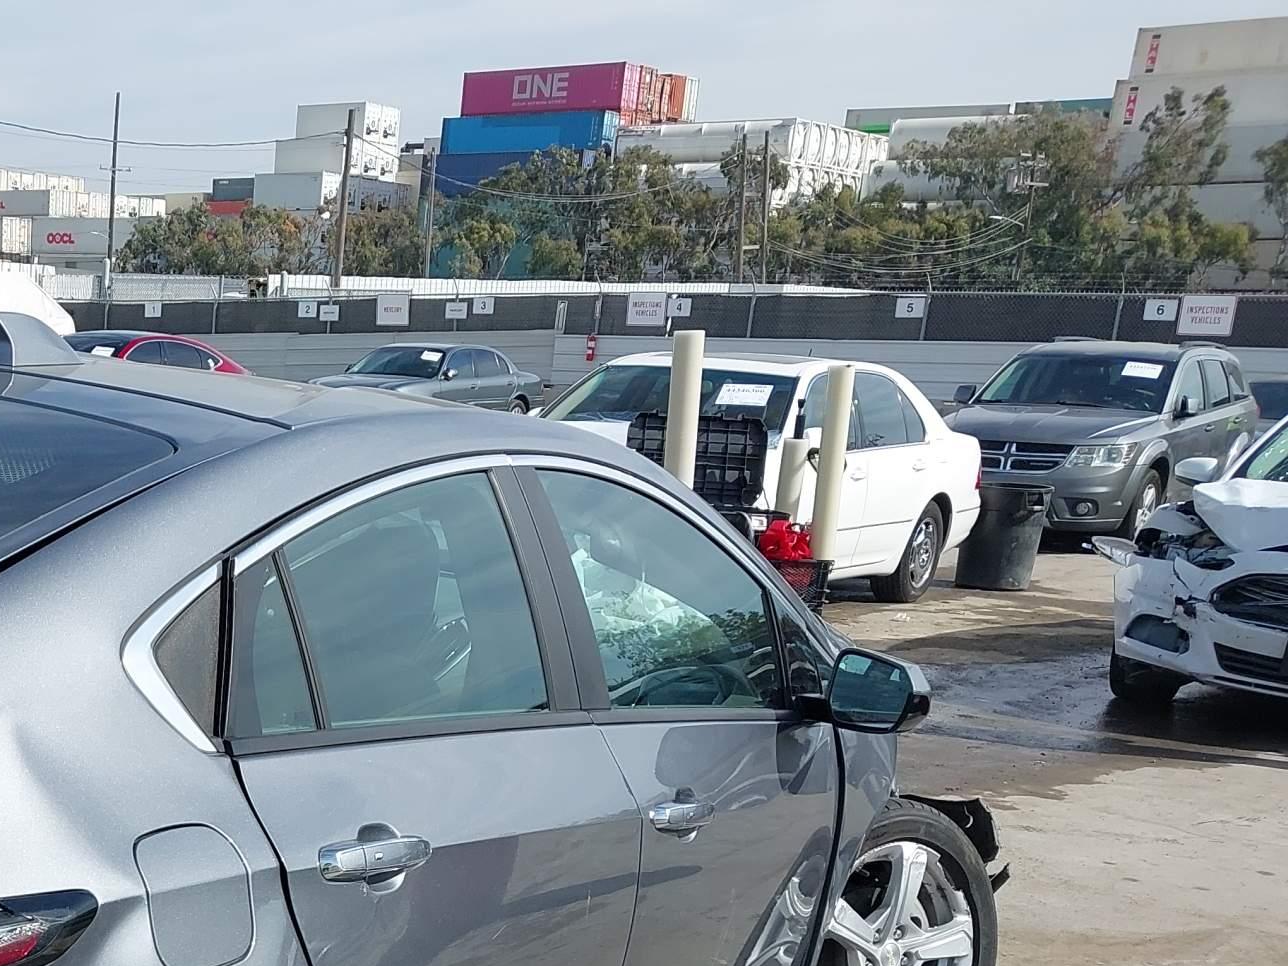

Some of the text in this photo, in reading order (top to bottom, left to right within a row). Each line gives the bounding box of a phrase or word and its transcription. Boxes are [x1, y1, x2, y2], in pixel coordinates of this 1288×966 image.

[512, 72, 569, 99] ONE
[46, 232, 75, 244] OOCL
[151, 305, 156, 313] 1
[304, 305, 310, 313] 2
[480, 301, 487, 310] 3
[676, 303, 682, 312] 4
[906, 303, 914, 313] 5
[1156, 304, 1165, 315] 6
[1186, 305, 1229, 314] INSPECTIONS
[1191, 316, 1222, 325] VEHICLES
